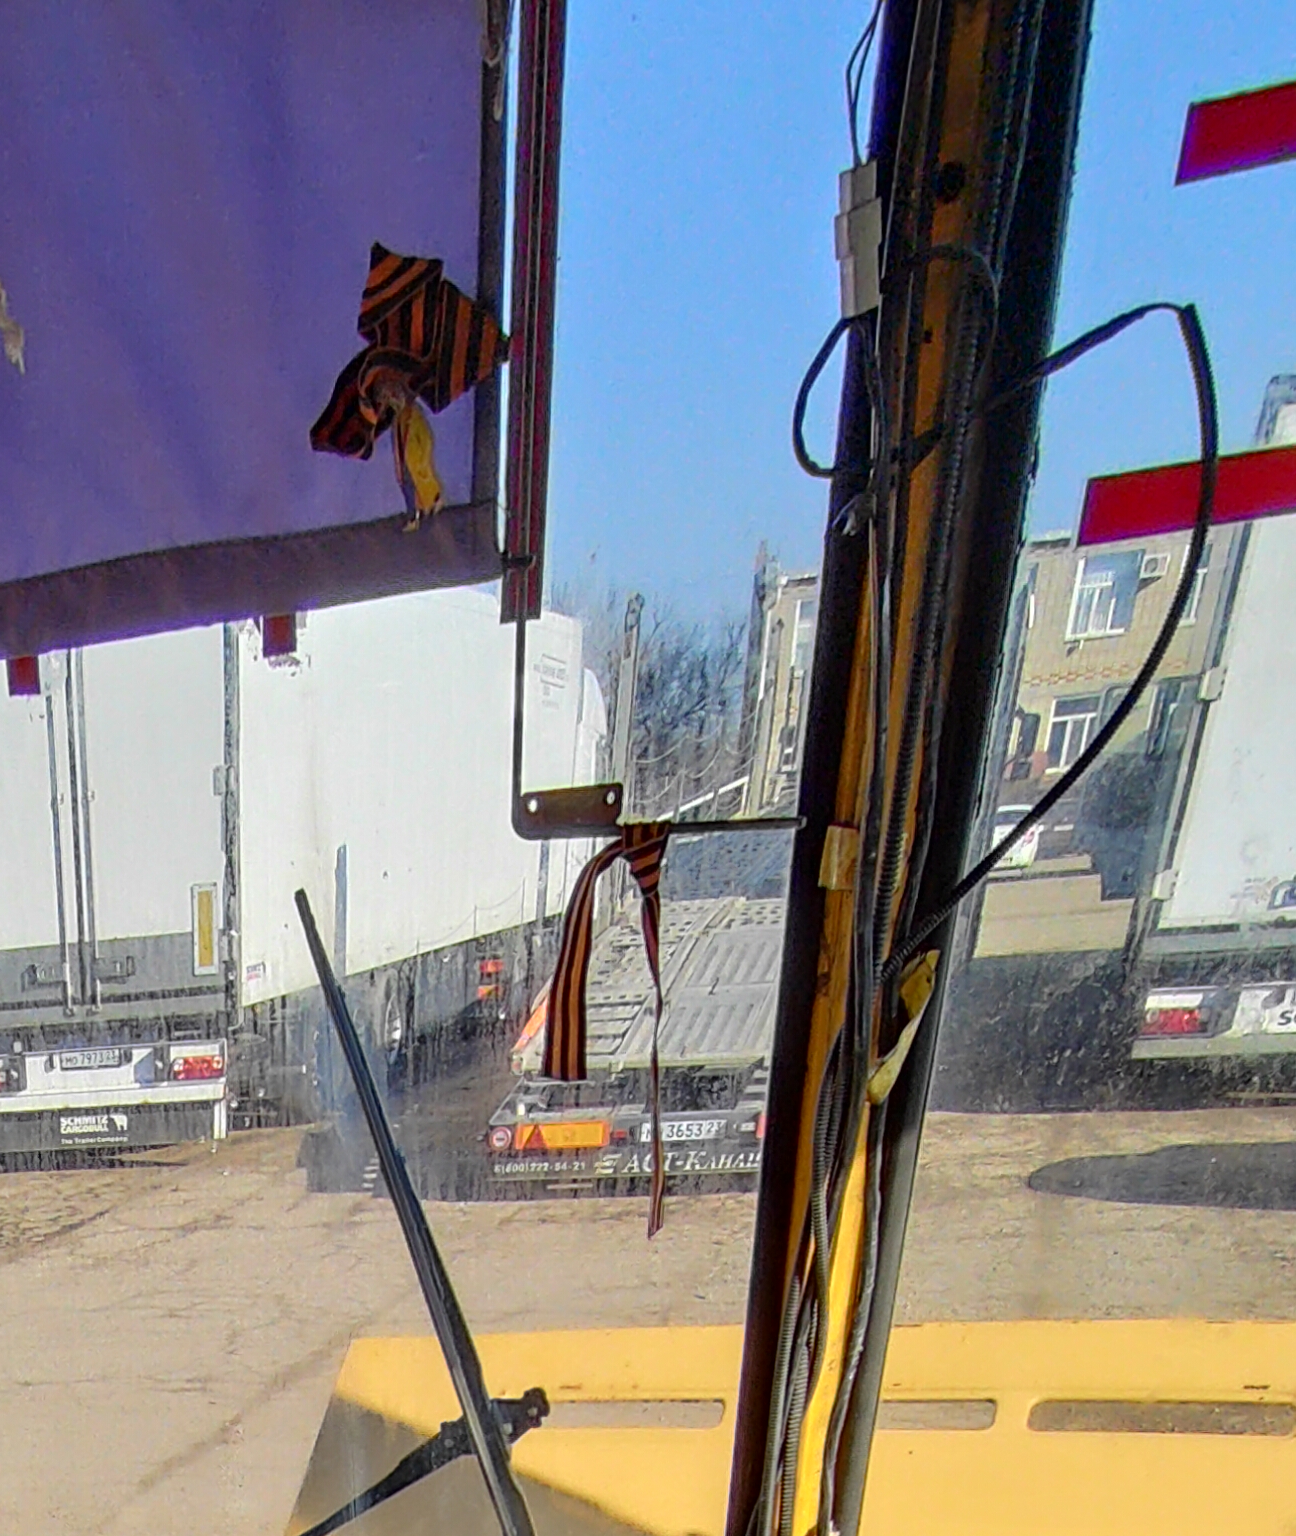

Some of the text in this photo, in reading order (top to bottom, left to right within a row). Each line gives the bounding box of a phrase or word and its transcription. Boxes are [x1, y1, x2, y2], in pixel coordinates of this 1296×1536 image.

[60, 1115, 109, 1126] SCHMITZ
[60, 1124, 109, 1134] CARGOBULL
[666, 1123, 703, 1138] 3653
